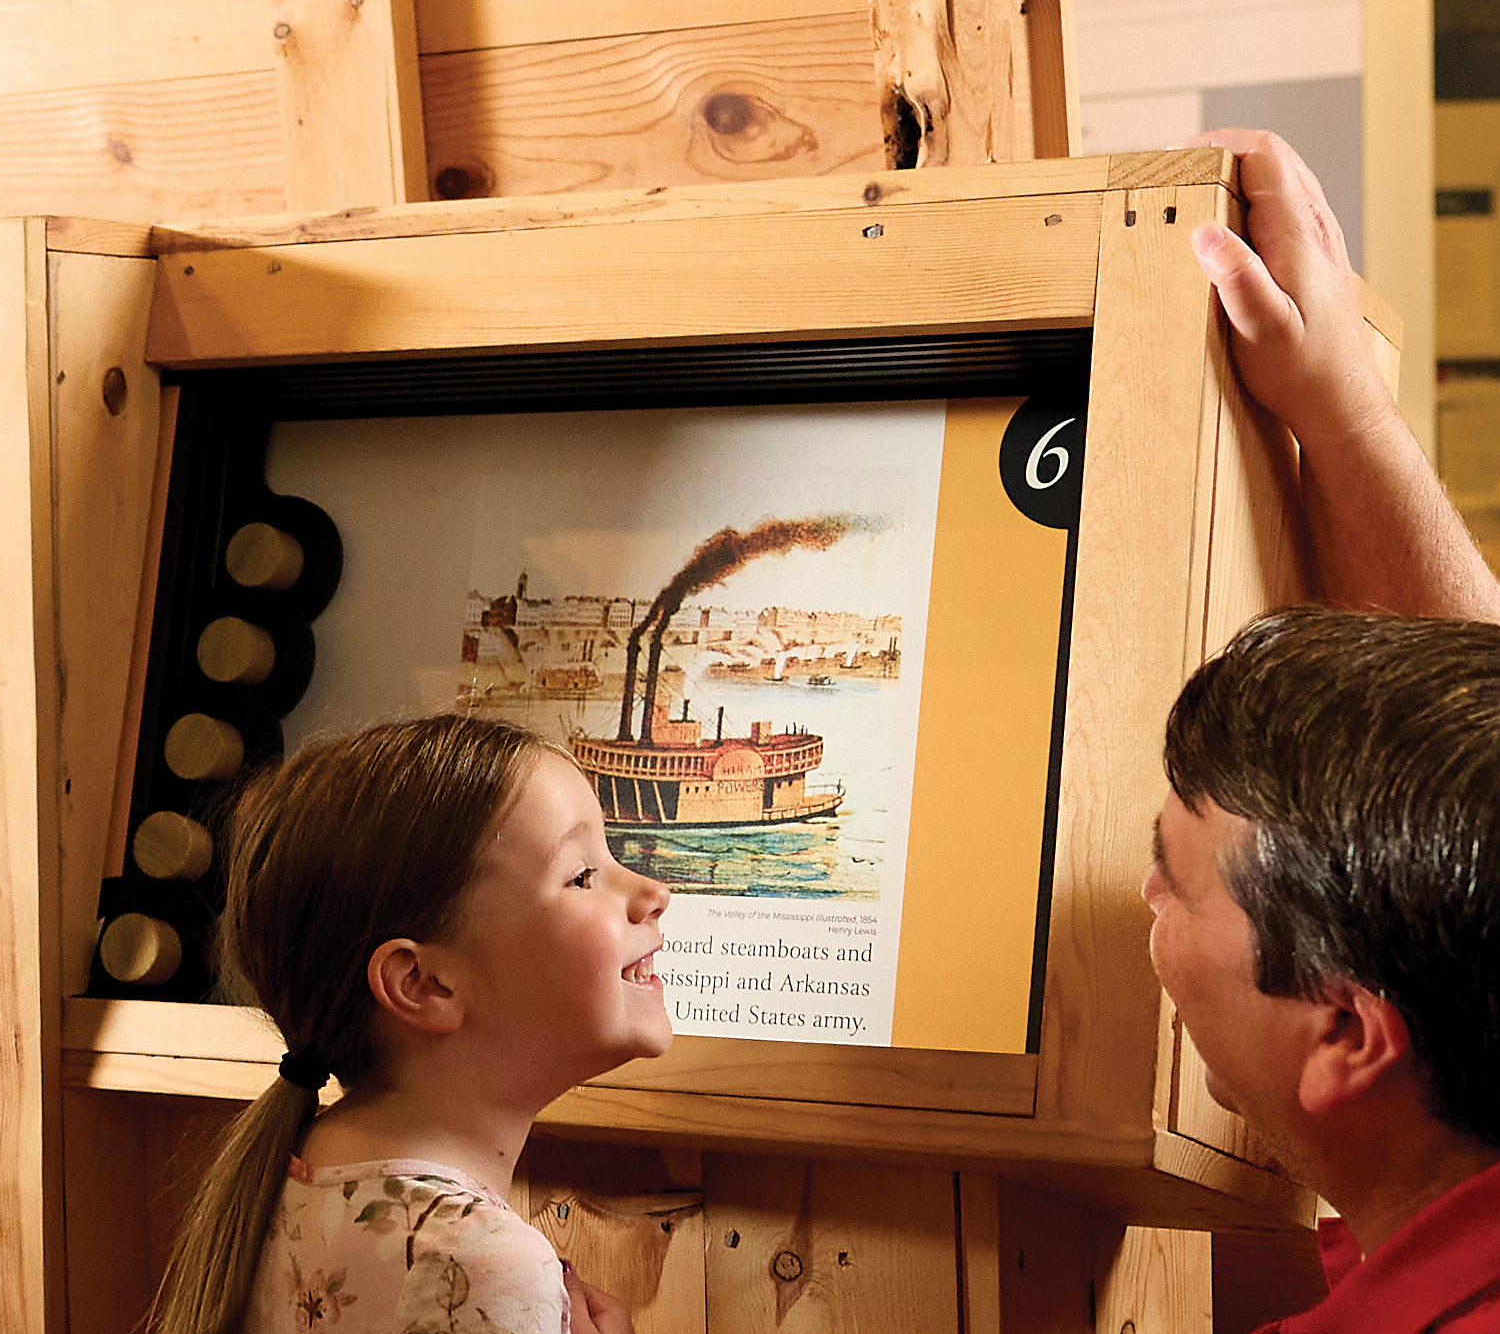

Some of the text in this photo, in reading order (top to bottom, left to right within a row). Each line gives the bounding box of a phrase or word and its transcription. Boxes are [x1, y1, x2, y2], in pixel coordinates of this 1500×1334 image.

[1025, 417, 1076, 489] 6
[708, 909, 878, 925] The Valley of the Mississippi Illustrated, 1854
[828, 925, 877, 937] Henry Lewis
[720, 938, 829, 961] steamboats
[836, 943, 873, 963] and
[737, 972, 773, 992] and
[780, 973, 871, 997] Arkansas
[675, 1001, 868, 1037] United States army.
